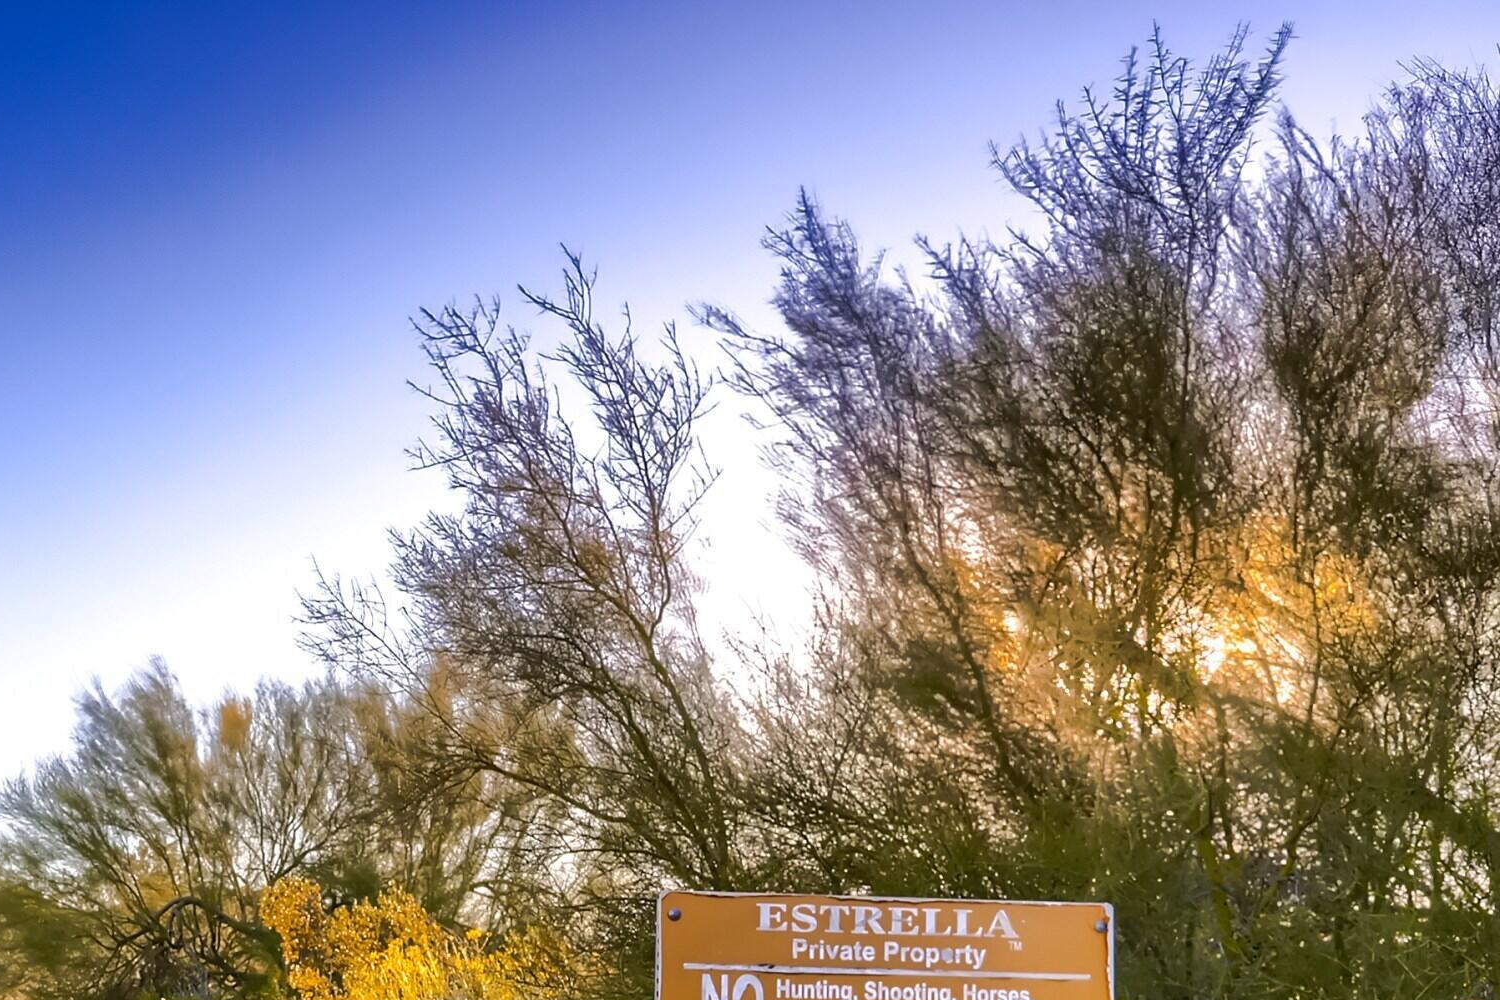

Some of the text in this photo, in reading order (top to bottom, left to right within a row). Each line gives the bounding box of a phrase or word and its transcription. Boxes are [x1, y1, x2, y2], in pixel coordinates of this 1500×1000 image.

[756, 903, 1019, 939] ESTRELLA
[792, 939, 987, 969] Private Property
[1009, 940, 1022, 951] TM
